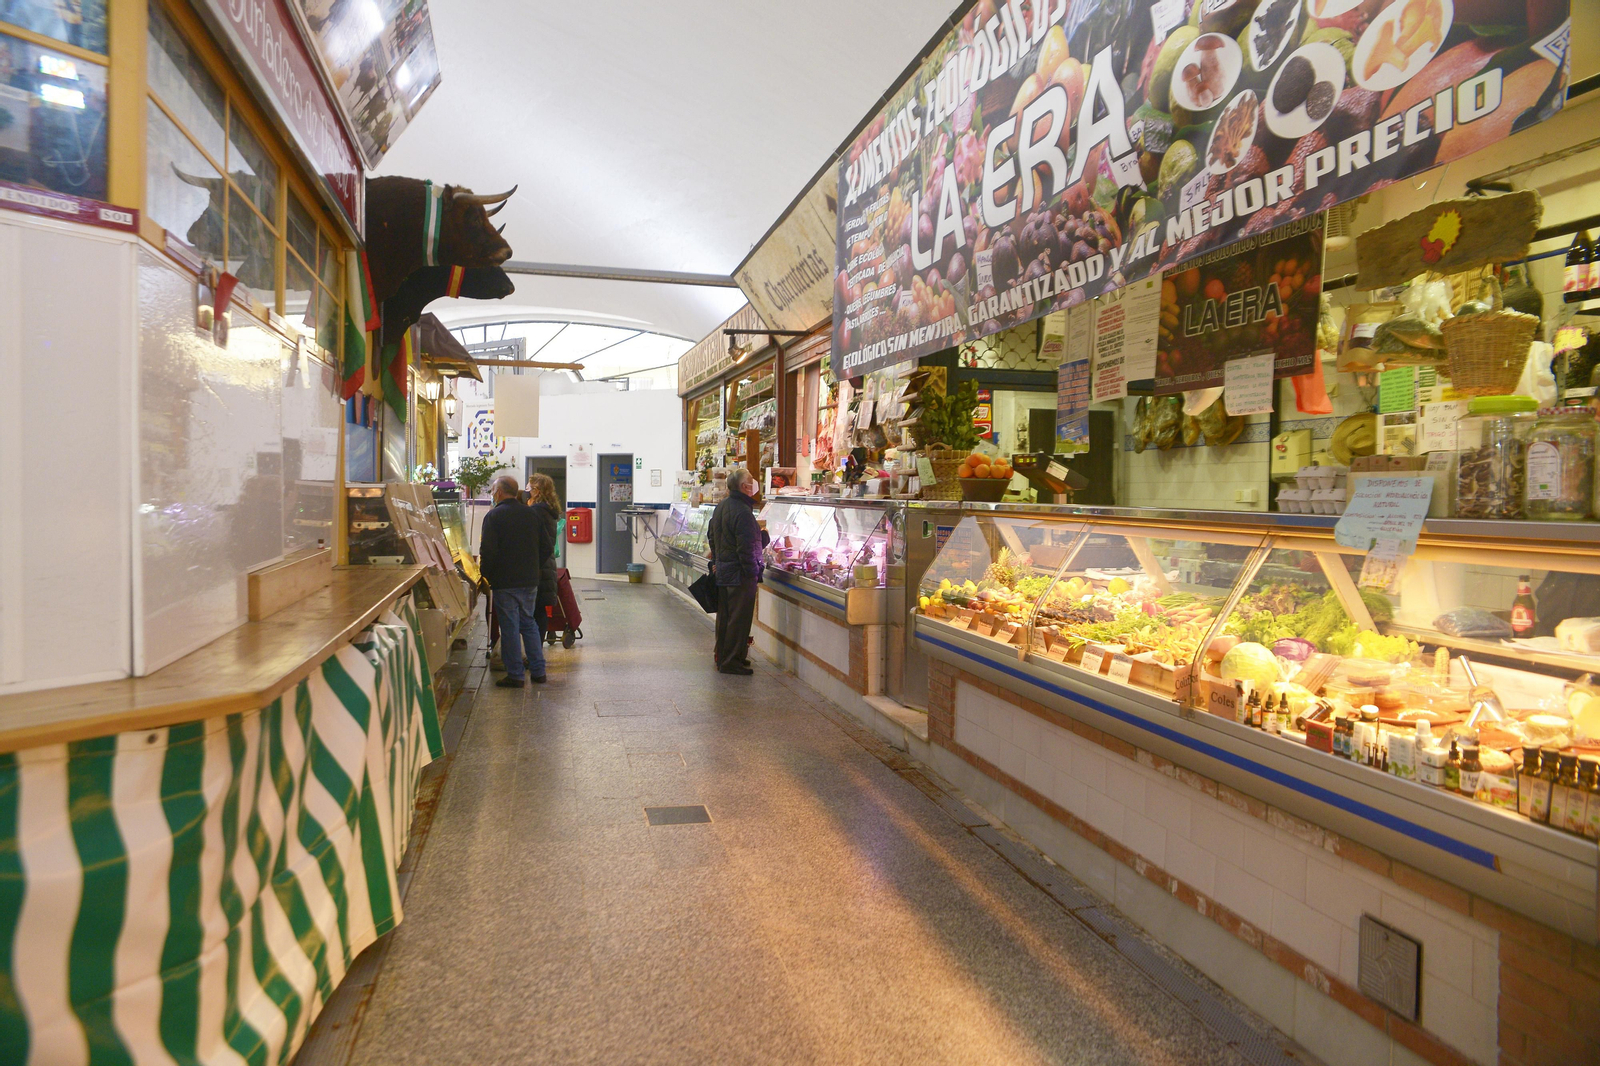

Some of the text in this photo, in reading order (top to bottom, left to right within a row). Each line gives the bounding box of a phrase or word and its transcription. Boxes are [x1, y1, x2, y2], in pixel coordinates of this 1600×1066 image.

[844, 101, 922, 209] ALIMENTOS
[911, 46, 1133, 272] LA ERA
[0, 187, 79, 213] ENDIDOS
[103, 210, 132, 224] SOL
[842, 339, 888, 371] ECOLÓGICO
[887, 333, 909, 354] SIN
[908, 312, 967, 348] MENTIRA,
[967, 251, 1105, 328] GARANTIZADO
[1108, 243, 1130, 272] Y
[1127, 229, 1161, 265] AL
[1165, 163, 1296, 249] MEJOR
[1304, 67, 1504, 191] PRECIO
[1183, 281, 1285, 338] LA ERA
[1274, 357, 1296, 370] UCHO
[1210, 691, 1236, 709] Coles
